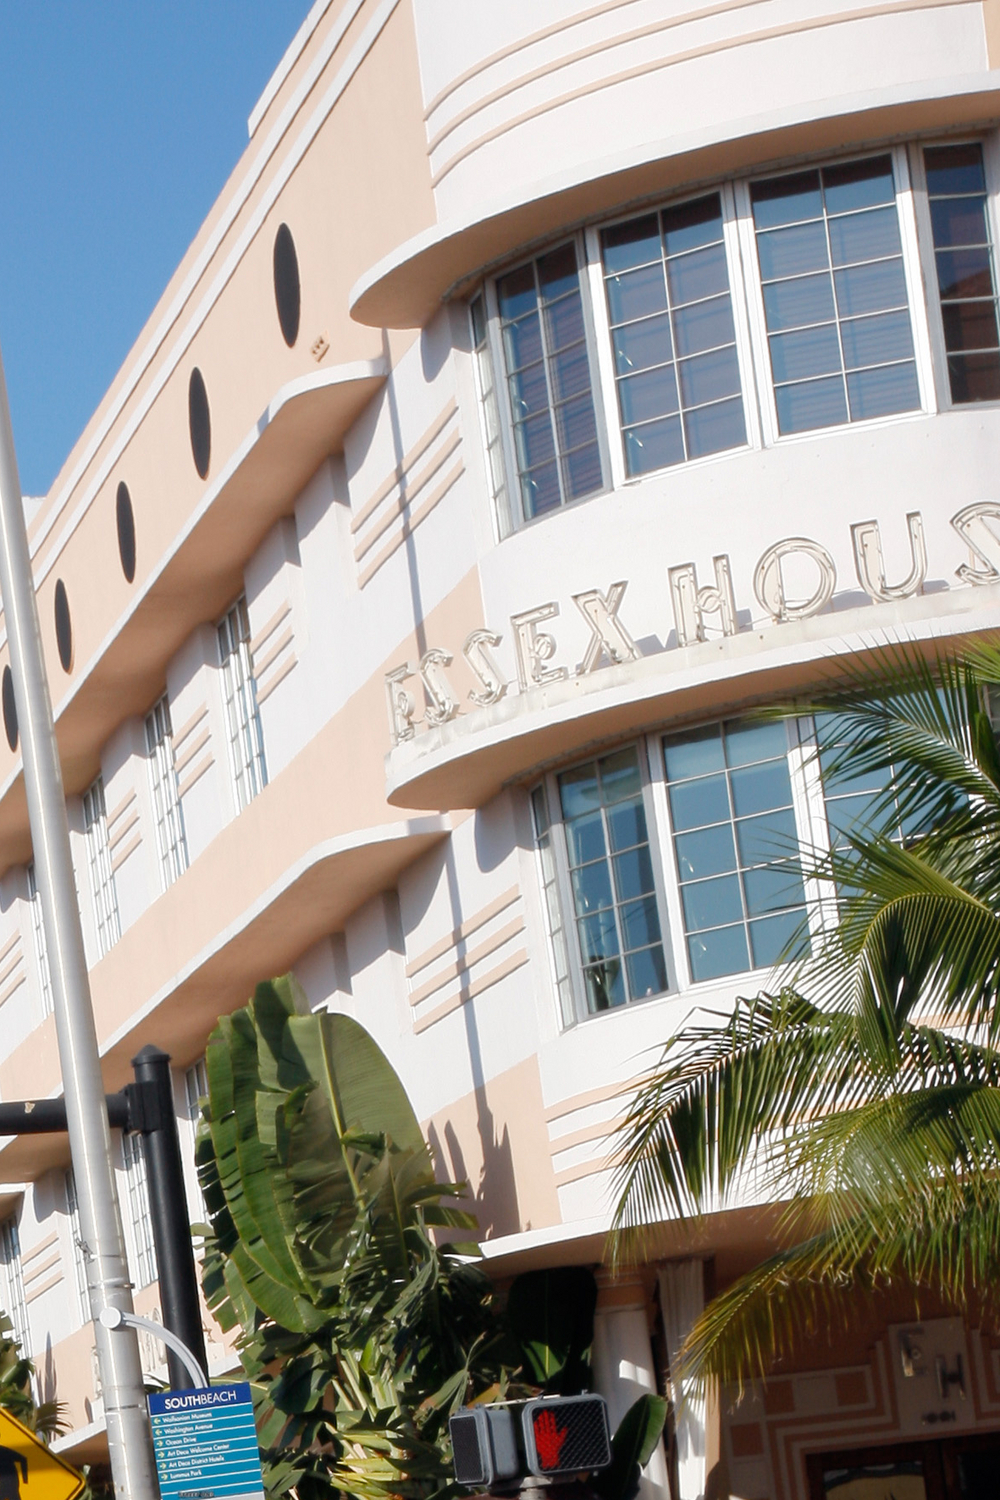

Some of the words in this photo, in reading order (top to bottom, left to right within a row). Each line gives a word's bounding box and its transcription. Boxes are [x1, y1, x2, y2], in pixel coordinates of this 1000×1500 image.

[385, 579, 643, 747] ESSEX
[164, 1426, 194, 1434] Washington
[195, 1423, 213, 1431] Avenue
[183, 1436, 197, 1444] Drive
[213, 1443, 230, 1451] Center
